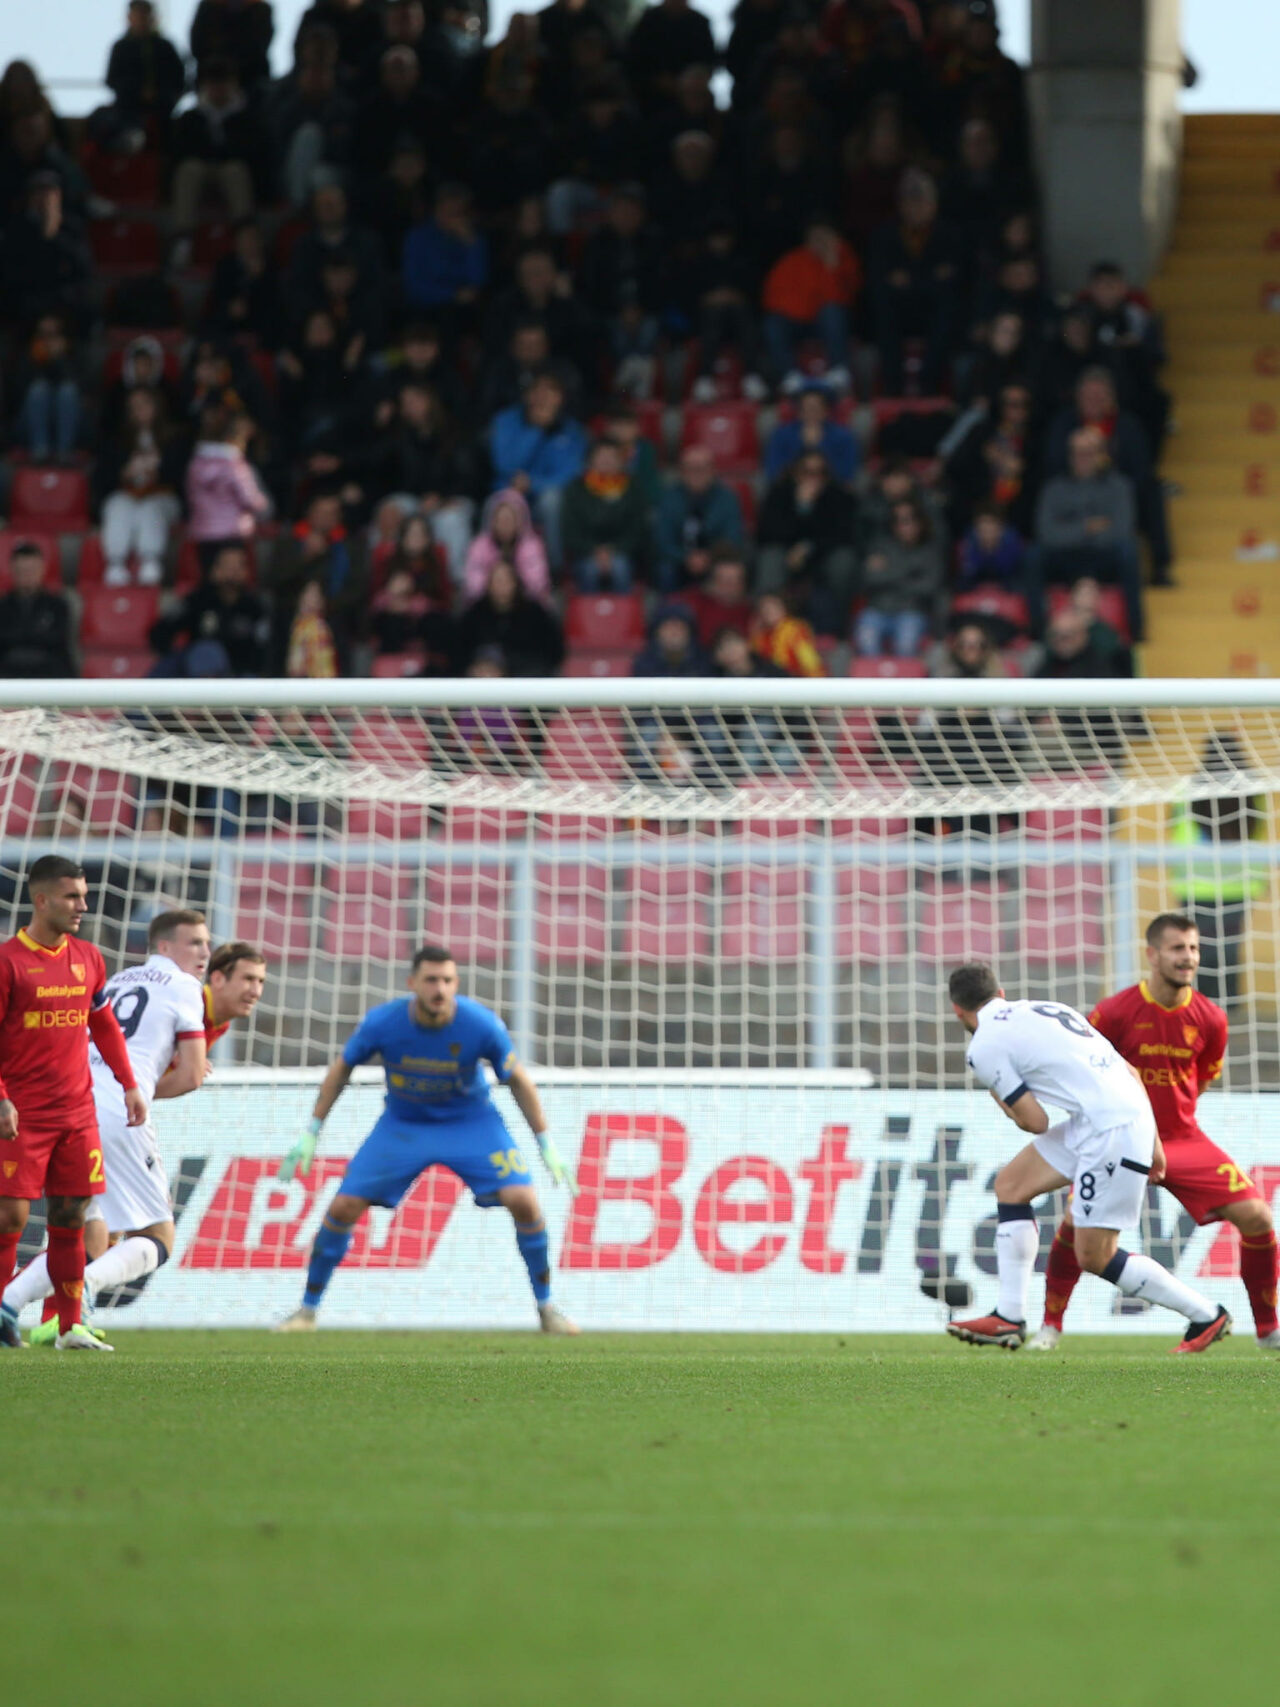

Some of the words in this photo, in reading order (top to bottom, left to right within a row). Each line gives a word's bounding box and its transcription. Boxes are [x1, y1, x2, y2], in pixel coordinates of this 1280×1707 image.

[42, 1009, 89, 1028] DEGH
[101, 985, 149, 1040] 9
[1080, 1172, 1096, 1200] 8
